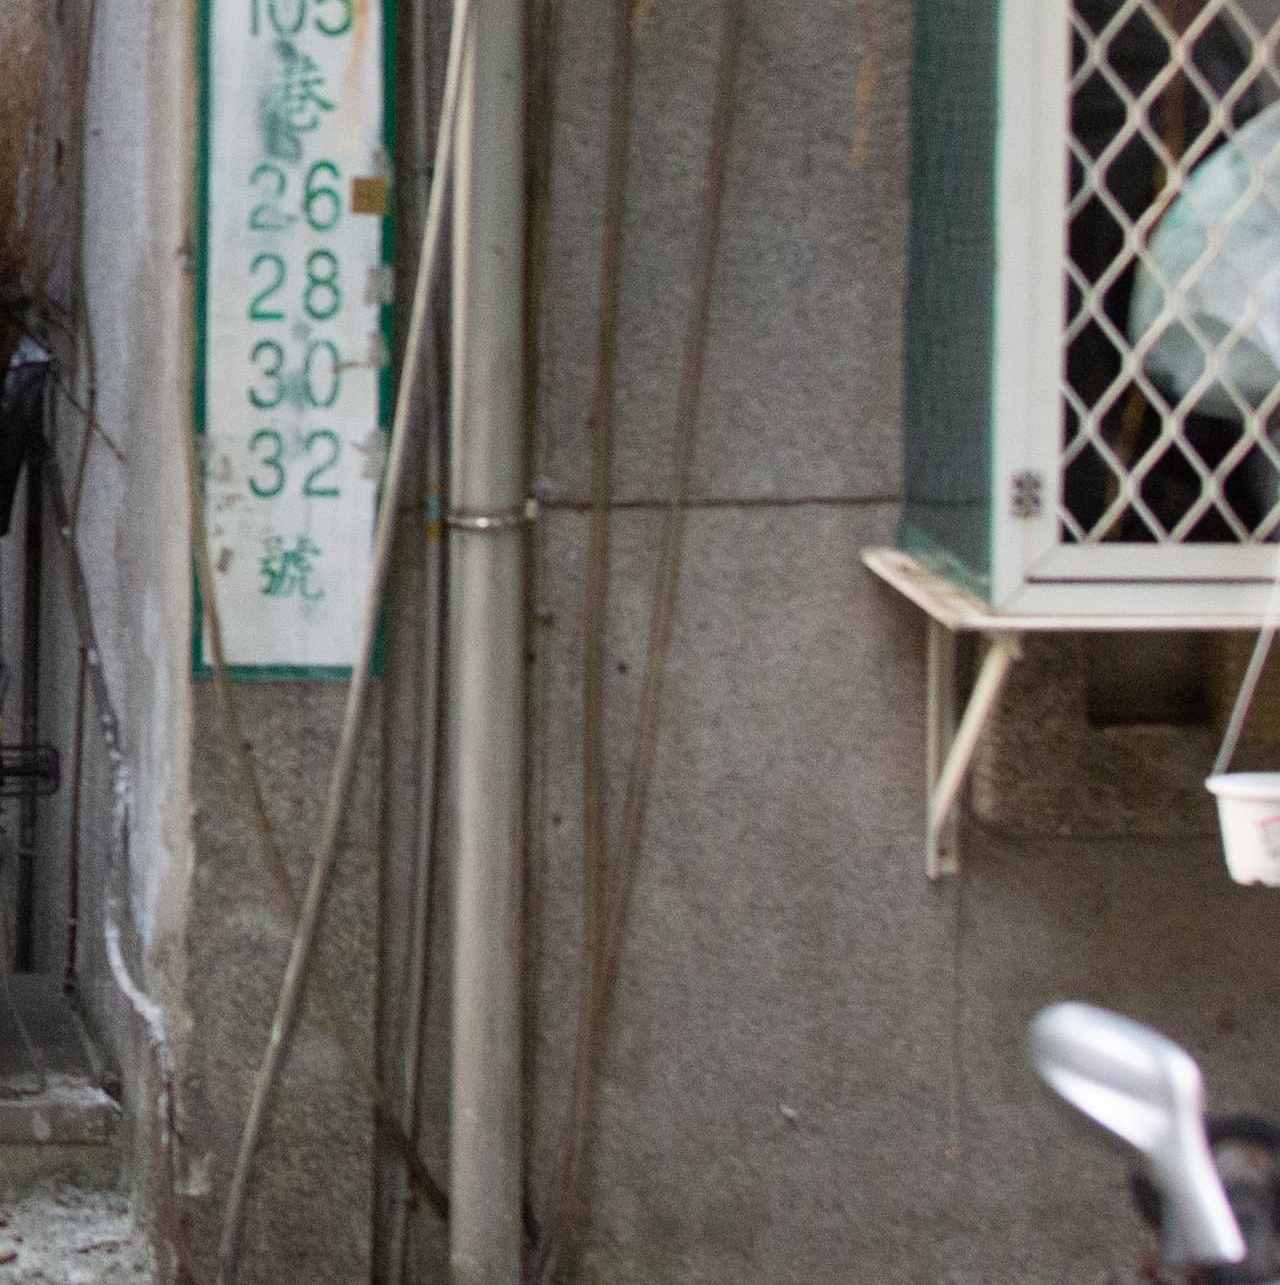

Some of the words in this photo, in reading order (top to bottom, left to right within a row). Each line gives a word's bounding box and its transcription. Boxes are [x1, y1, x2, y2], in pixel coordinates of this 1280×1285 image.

[247, 159, 343, 233] 26
[248, 248, 342, 322] 28
[247, 339, 342, 411] 30
[246, 428, 343, 499] 32
